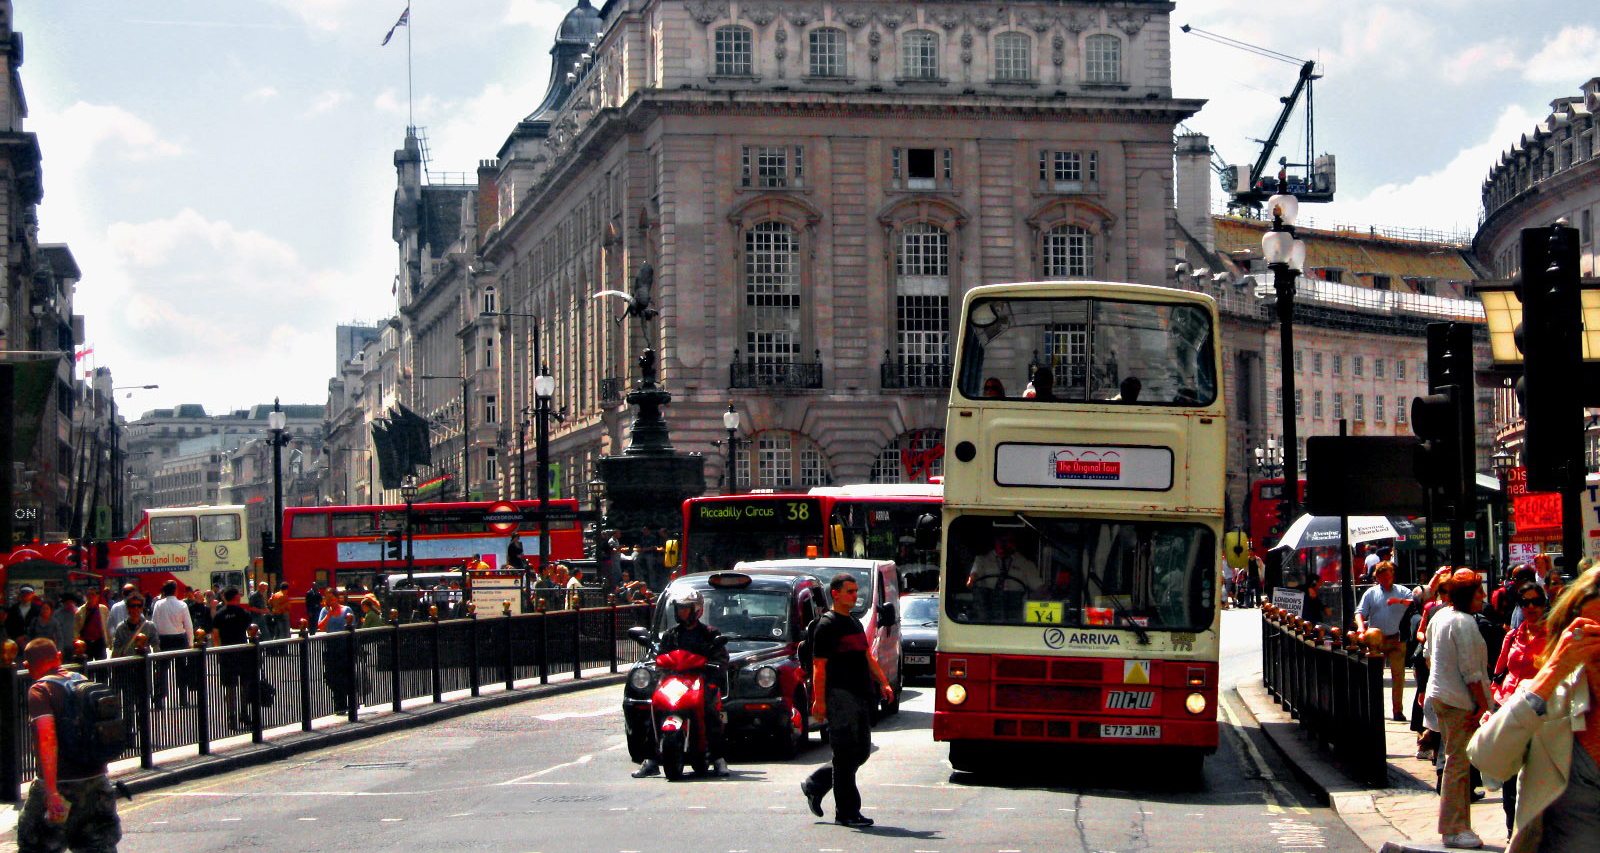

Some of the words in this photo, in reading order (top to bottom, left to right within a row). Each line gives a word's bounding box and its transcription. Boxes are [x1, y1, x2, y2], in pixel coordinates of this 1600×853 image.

[1060, 461, 1071, 472] The
[1073, 461, 1101, 473] Original
[1103, 462, 1117, 473] Tour
[786, 502, 809, 520] 38
[1517, 498, 1561, 514] GEORGE
[15, 508, 36, 519] ON
[700, 506, 742, 520] Piccadilly
[745, 505, 774, 517] Circus
[1517, 512, 1562, 526] MICHAEL
[1521, 543, 1538, 554] ARE
[127, 555, 139, 566] The
[141, 553, 170, 567] Original
[172, 553, 187, 564] Tour
[1274, 596, 1302, 605] LONDON'S
[1034, 610, 1054, 622] Y4
[1069, 633, 1120, 645] ARRIVA
[1104, 725, 1133, 736] E773
[1136, 725, 1156, 737] JAR
